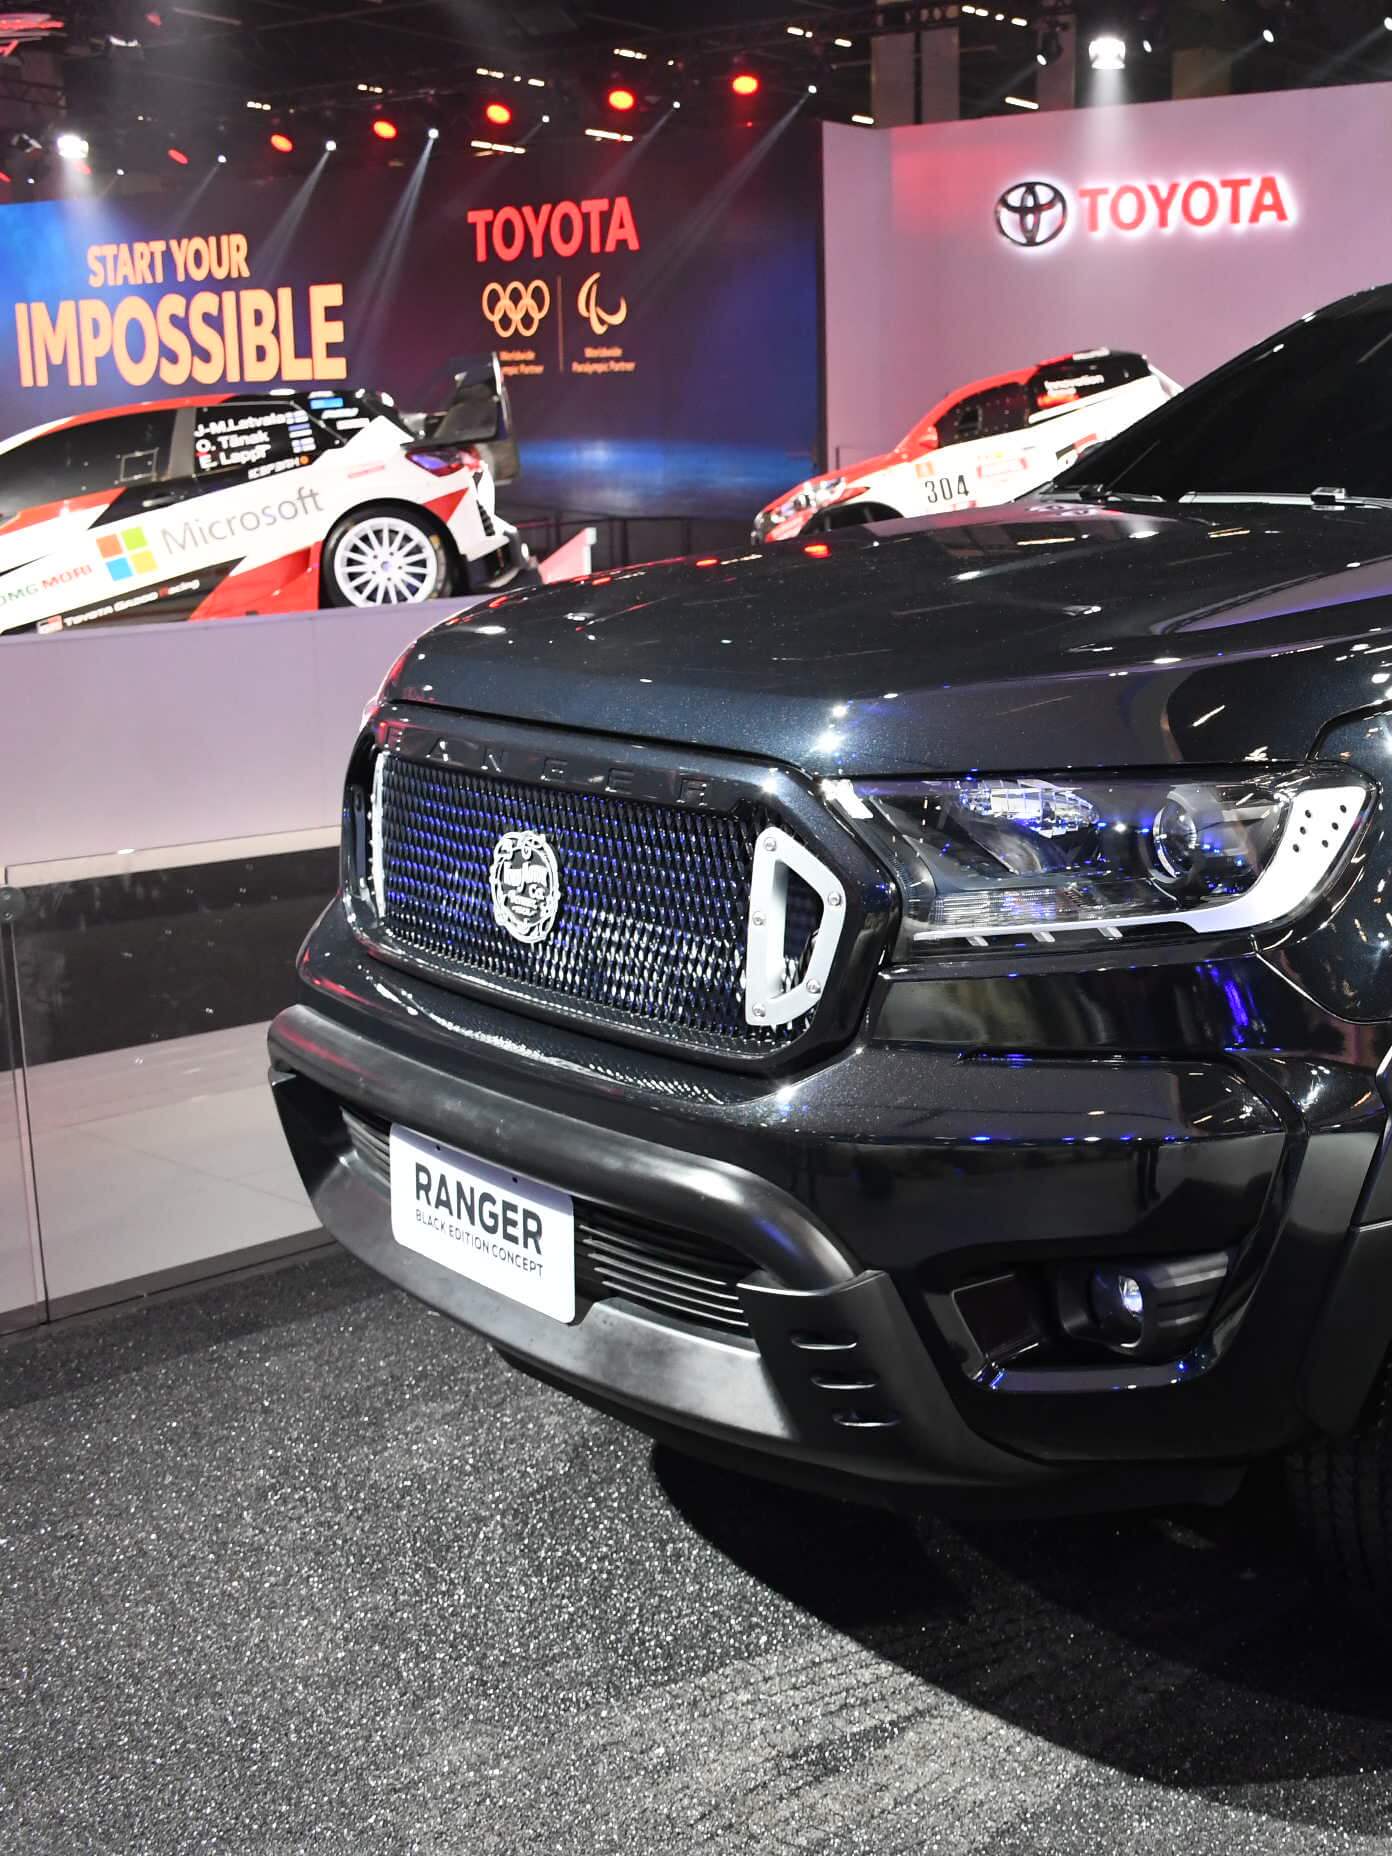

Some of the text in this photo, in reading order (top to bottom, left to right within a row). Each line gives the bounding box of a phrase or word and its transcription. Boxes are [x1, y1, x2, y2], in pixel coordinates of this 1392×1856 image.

[466, 196, 640, 262] TOYOTA
[1077, 175, 1289, 233] TOYOTA
[87, 233, 251, 287] START YOUR
[15, 283, 348, 387] IMPOSSIBLE
[161, 486, 324, 555] Microsoft
[925, 475, 969, 503] 304
[415, 1161, 543, 1255] RANGER
[416, 1208, 544, 1278] BLACK EDITION CONCEPT
